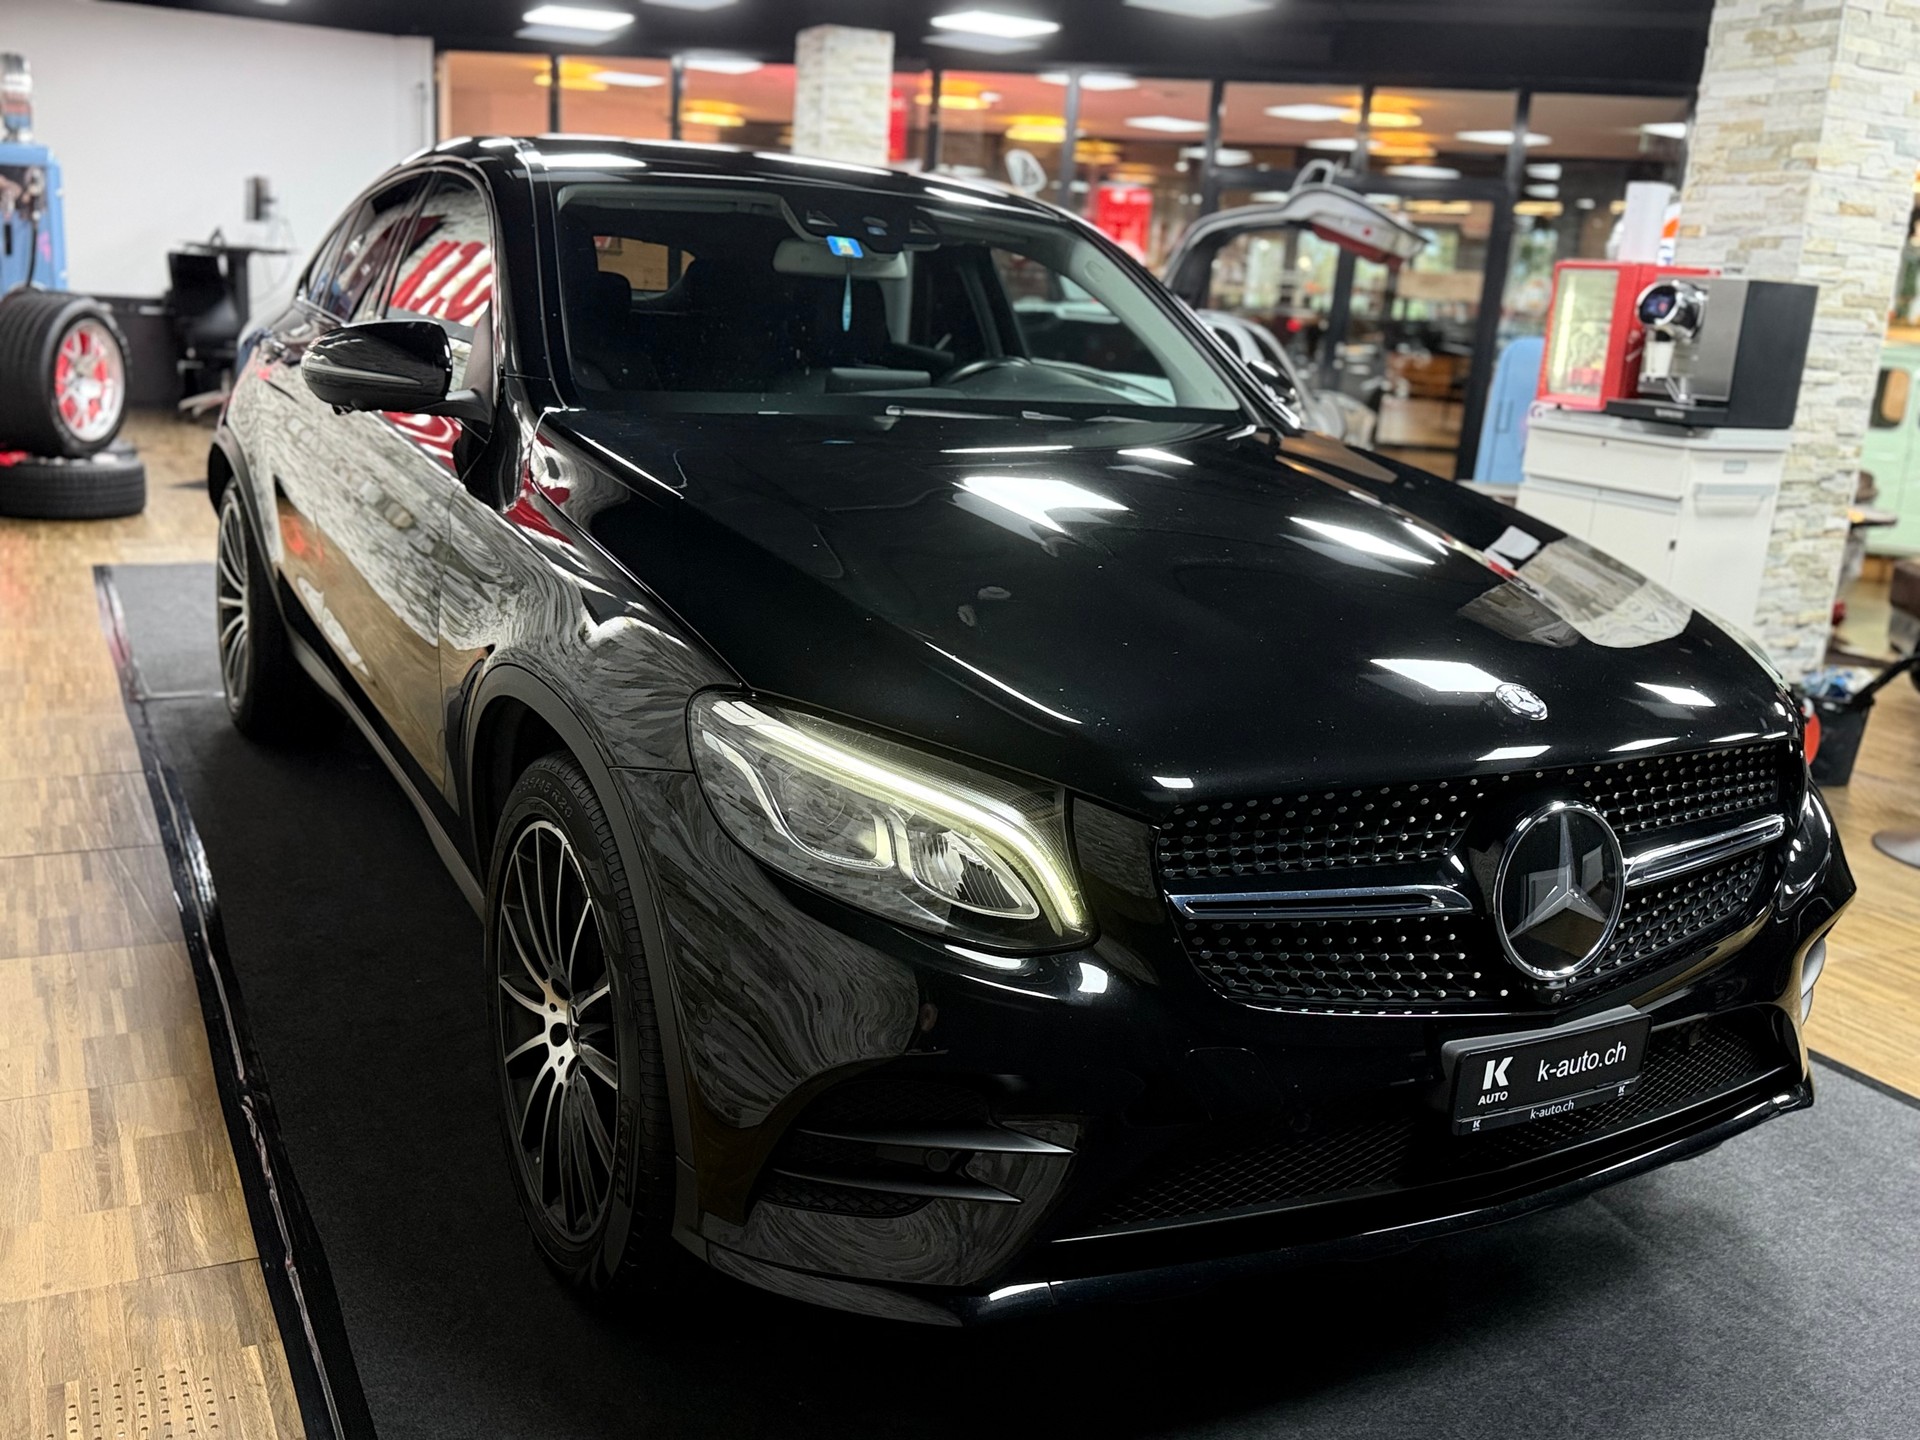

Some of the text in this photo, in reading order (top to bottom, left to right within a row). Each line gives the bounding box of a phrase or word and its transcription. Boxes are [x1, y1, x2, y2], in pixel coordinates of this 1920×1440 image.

[1482, 1056, 1514, 1091] K
[1536, 1041, 1628, 1082] k-auto.ch
[1477, 1090, 1509, 1106] AUTO
[1529, 1100, 1575, 1120] k-auto.ch
